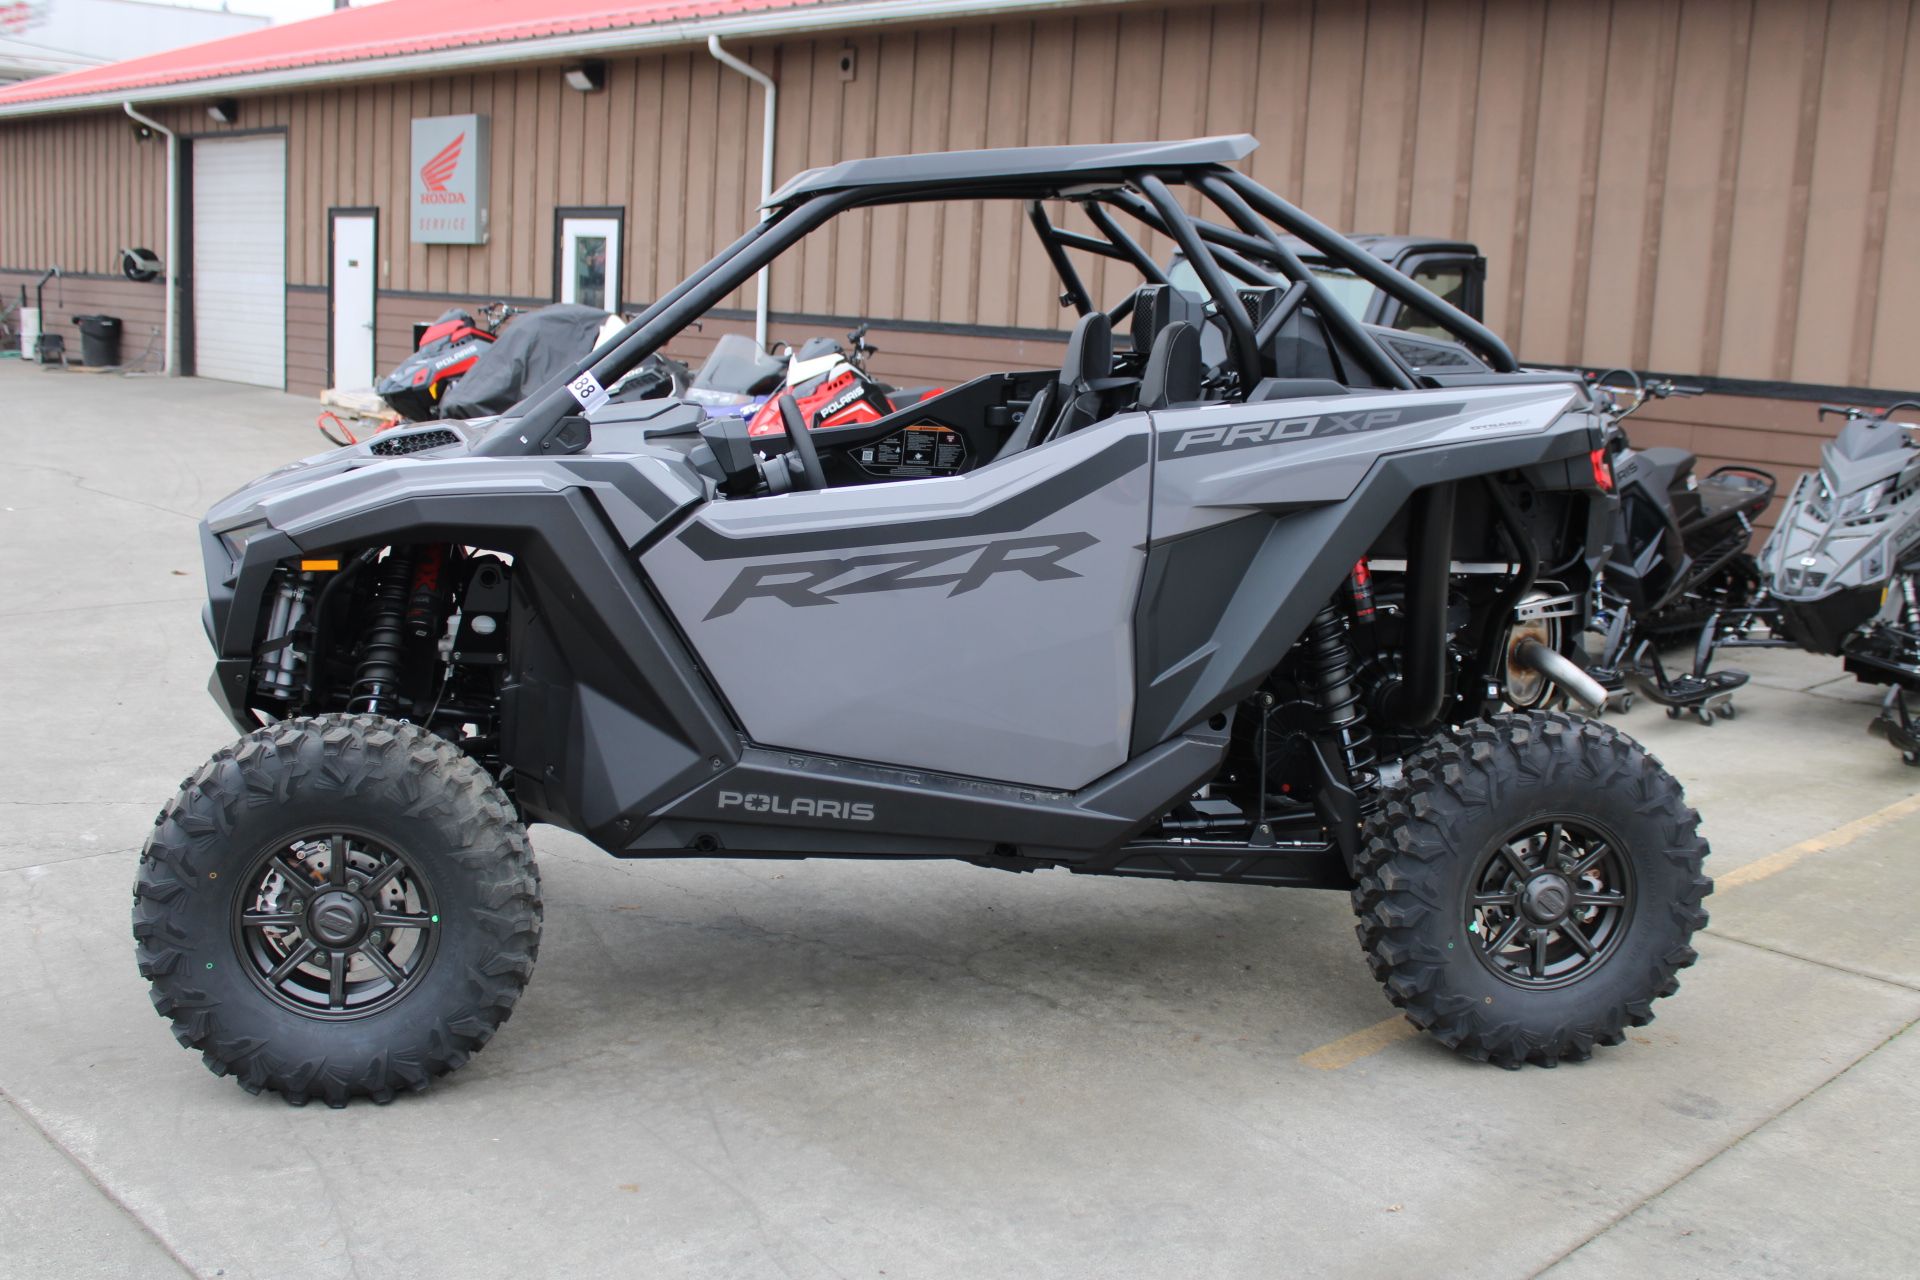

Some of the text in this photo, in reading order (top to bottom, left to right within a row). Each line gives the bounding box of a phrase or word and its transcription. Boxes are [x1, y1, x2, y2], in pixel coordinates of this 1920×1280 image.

[420, 191, 466, 205] HONDA
[419, 217, 466, 231] SERVICE
[435, 344, 478, 370] POLARIS
[574, 377, 596, 398] 88
[820, 386, 865, 418] POLARIS
[1173, 409, 1403, 453] PRO XP
[701, 531, 1101, 623] RZR
[718, 790, 875, 821] POLARIS
